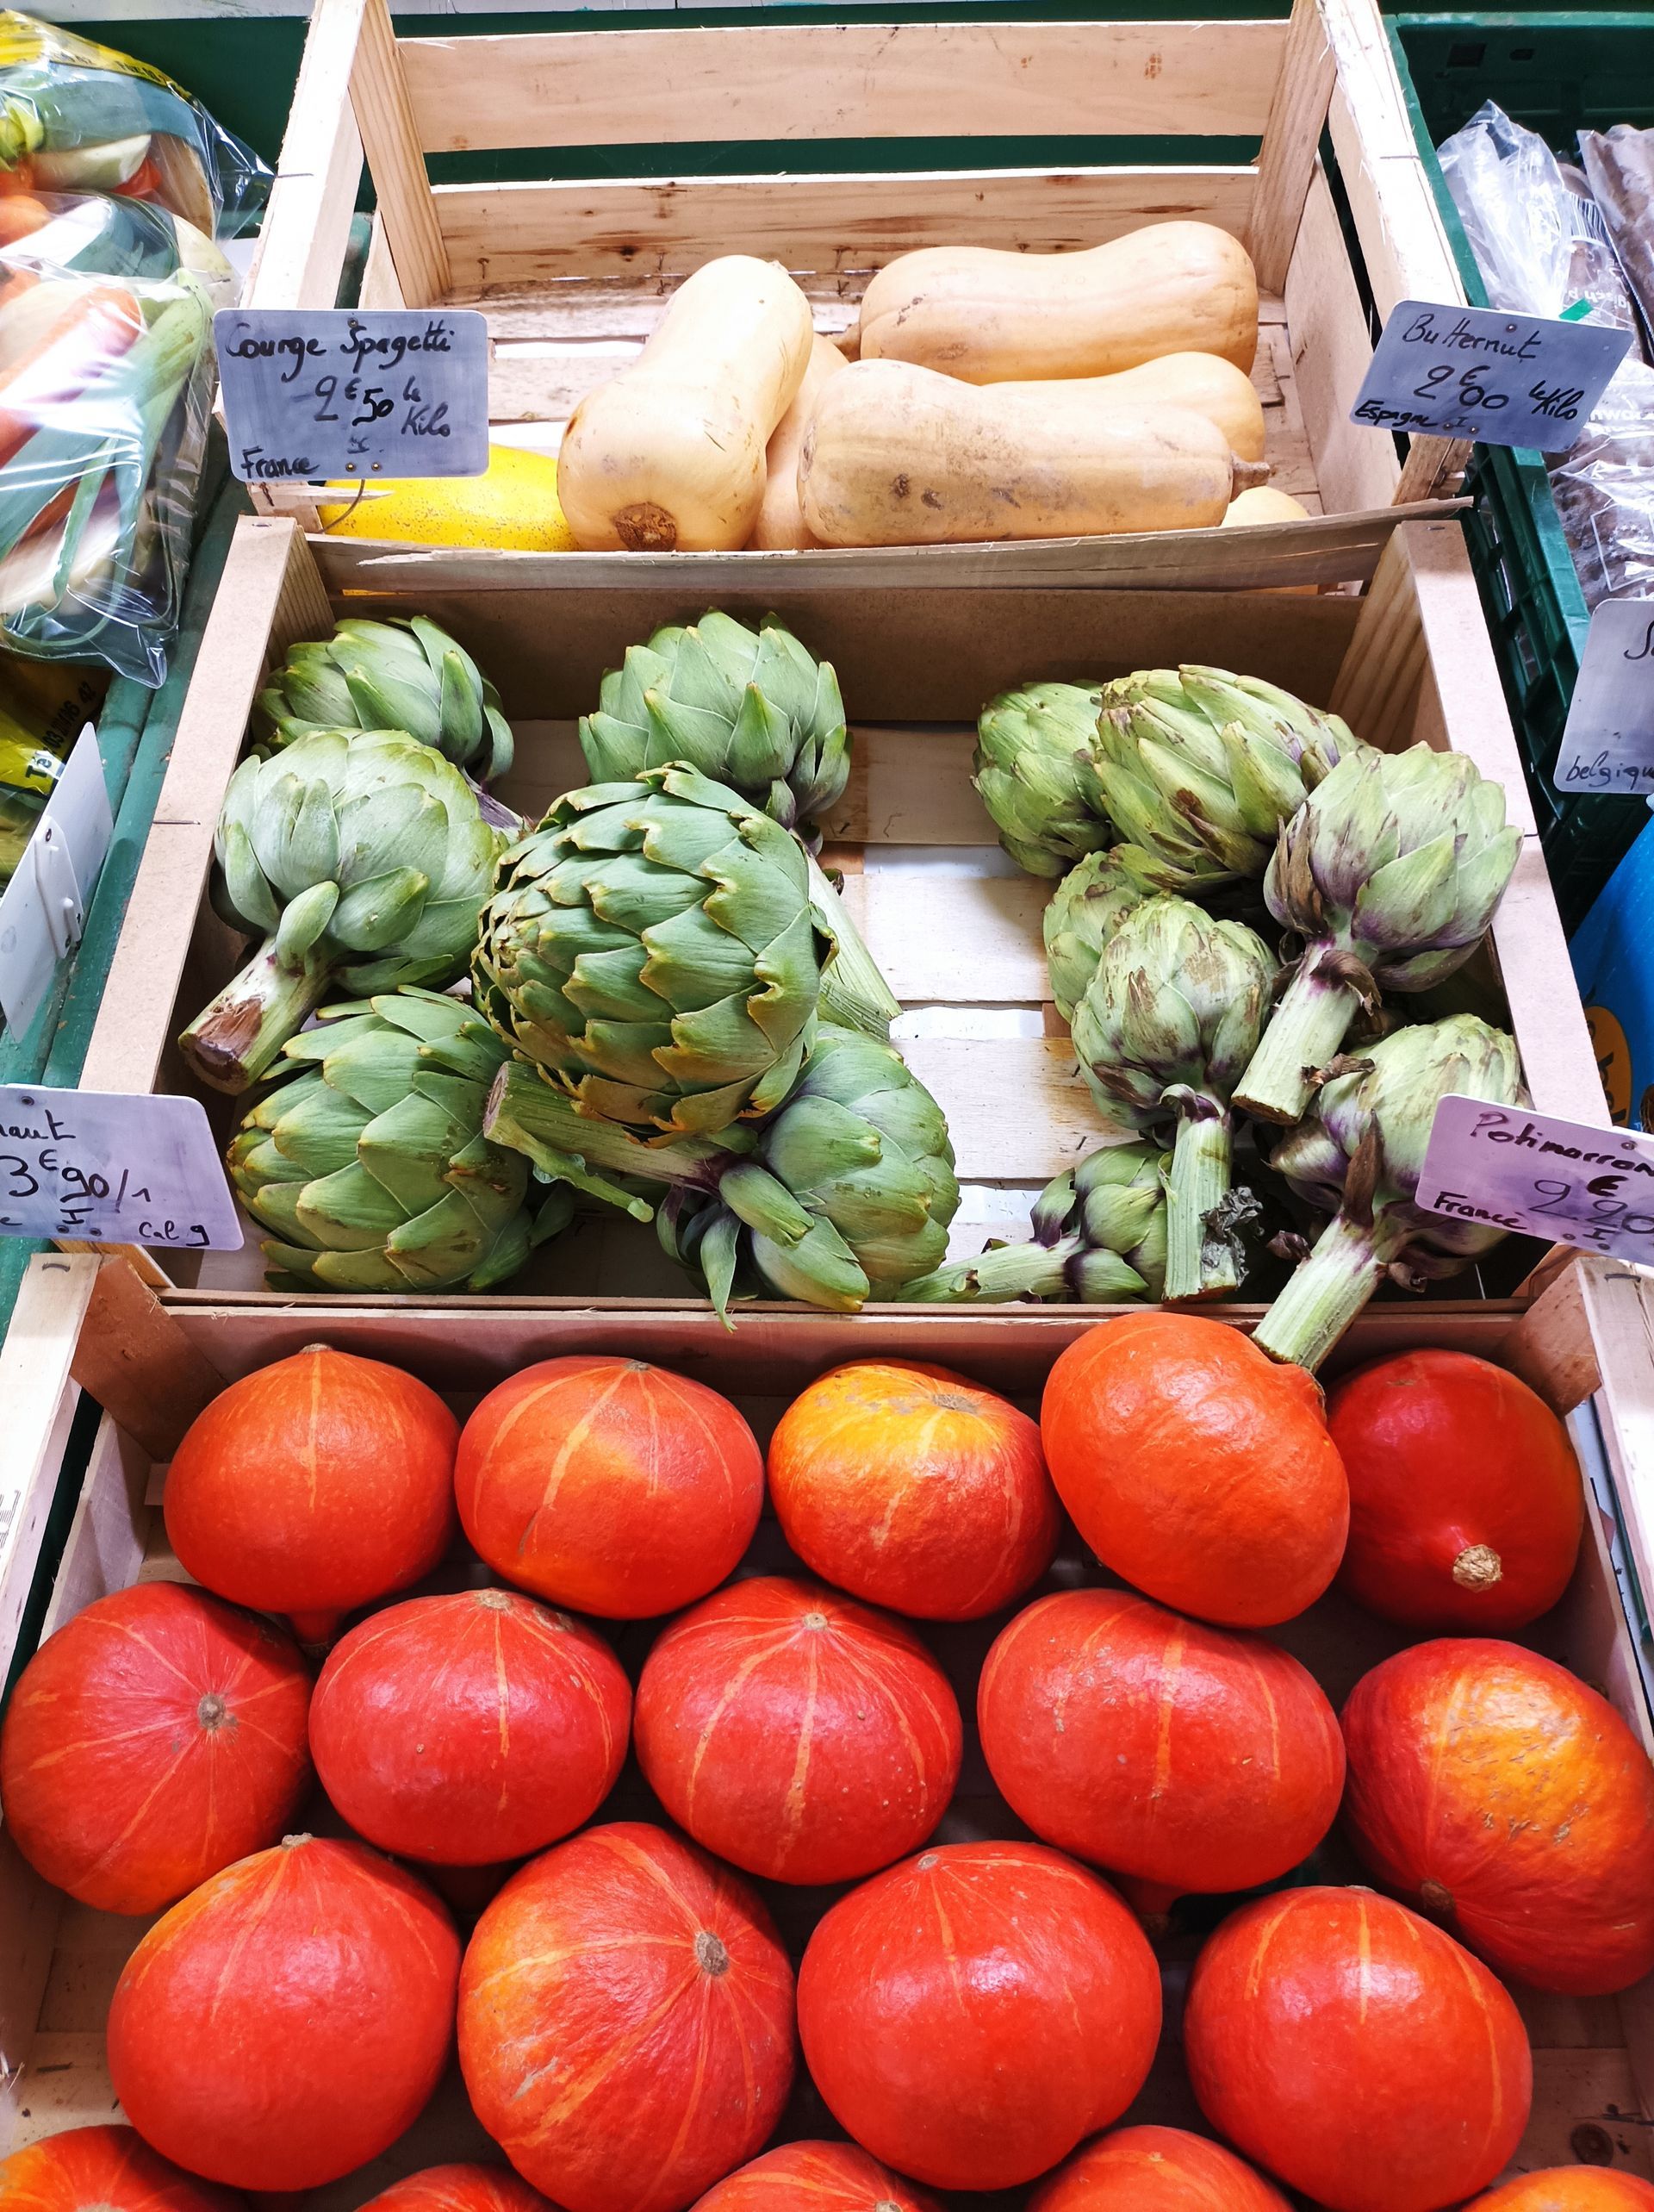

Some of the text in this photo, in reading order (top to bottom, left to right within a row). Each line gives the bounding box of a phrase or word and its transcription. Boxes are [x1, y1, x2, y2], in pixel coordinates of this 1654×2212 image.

[226, 319, 455, 383] Courge Spagetti
[1402, 314, 1541, 359] Butternut
[401, 402, 451, 437] Kilo
[1531, 388, 1585, 421] Kilo
[241, 446, 320, 478] France
[1433, 1191, 1527, 1230] France
